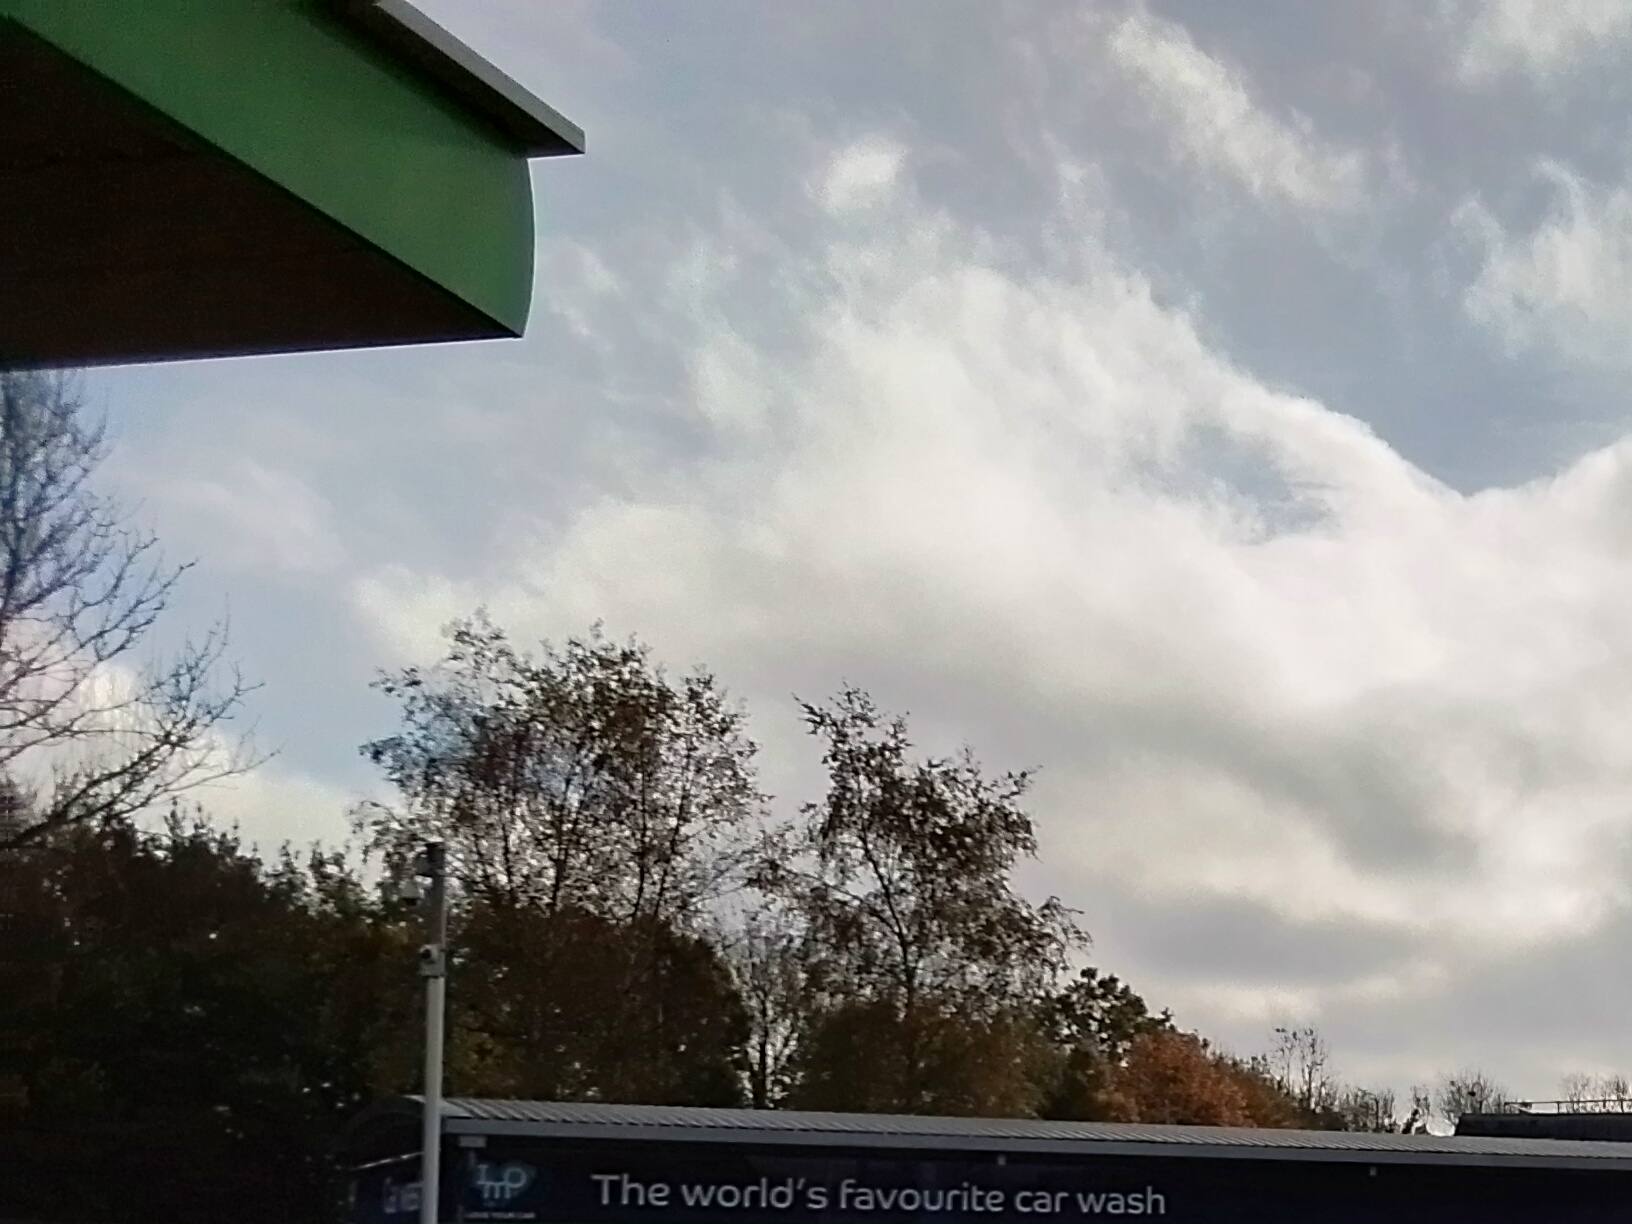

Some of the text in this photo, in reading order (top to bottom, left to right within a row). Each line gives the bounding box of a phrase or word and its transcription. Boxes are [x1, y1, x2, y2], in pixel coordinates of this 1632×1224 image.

[590, 1173, 1166, 1215] The world's favourite car wash
